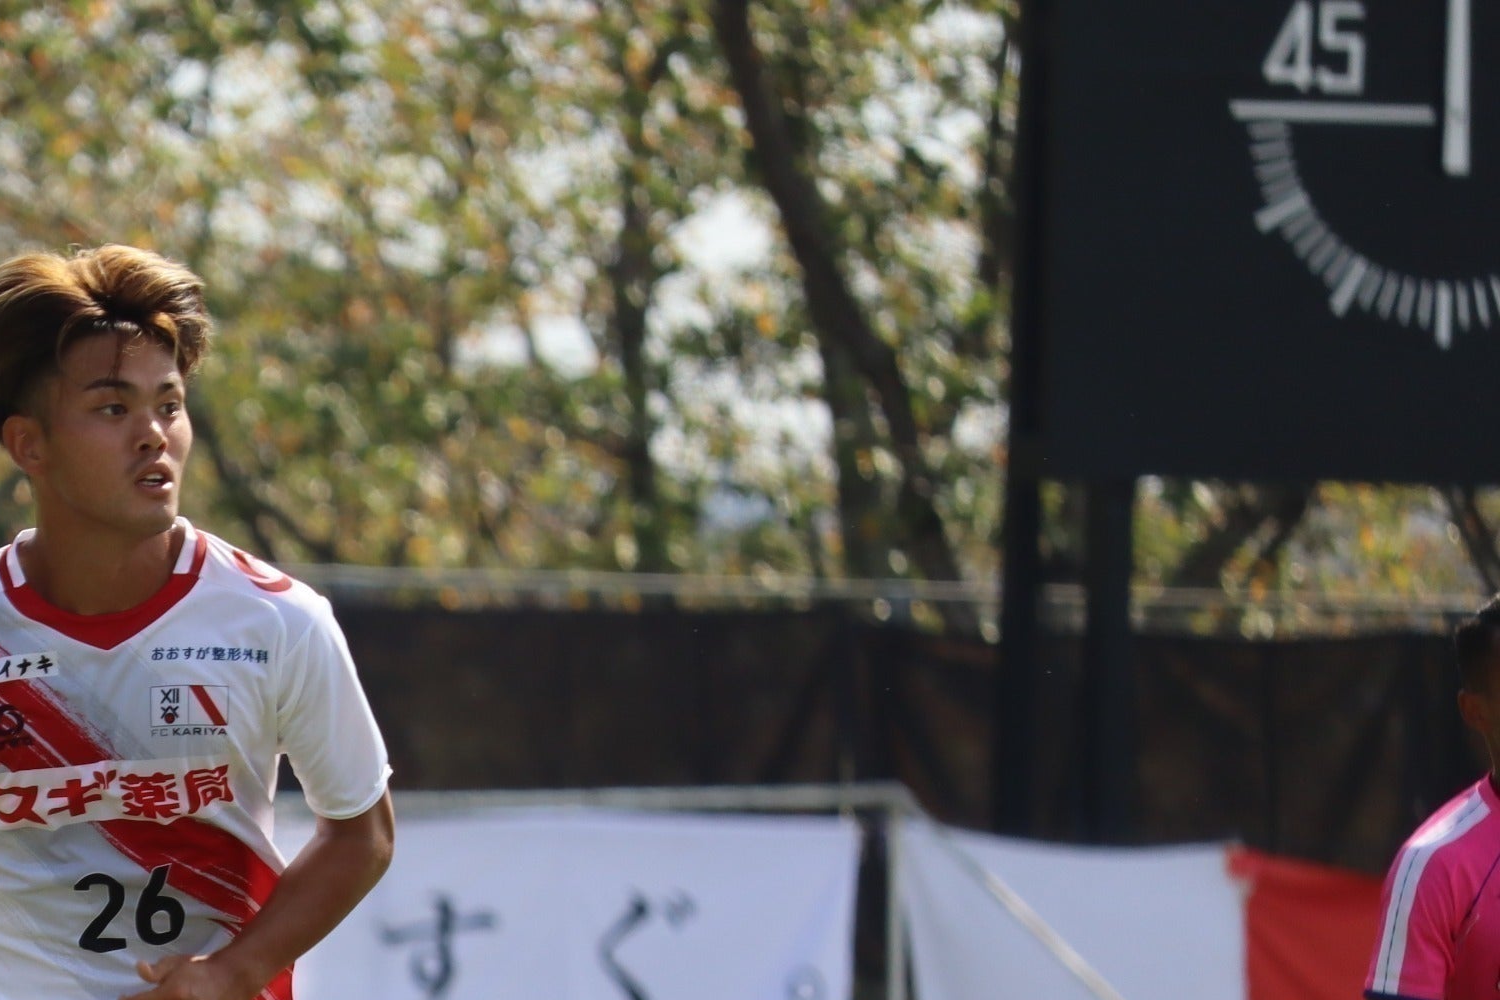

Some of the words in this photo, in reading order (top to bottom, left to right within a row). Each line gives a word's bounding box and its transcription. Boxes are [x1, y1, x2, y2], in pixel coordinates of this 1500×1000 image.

[1262, 0, 1366, 95] 45
[151, 647, 268, 664] おおすが整形外科
[150, 728, 169, 737] FC
[172, 727, 228, 736] KARIYA
[73, 862, 186, 953] 26
